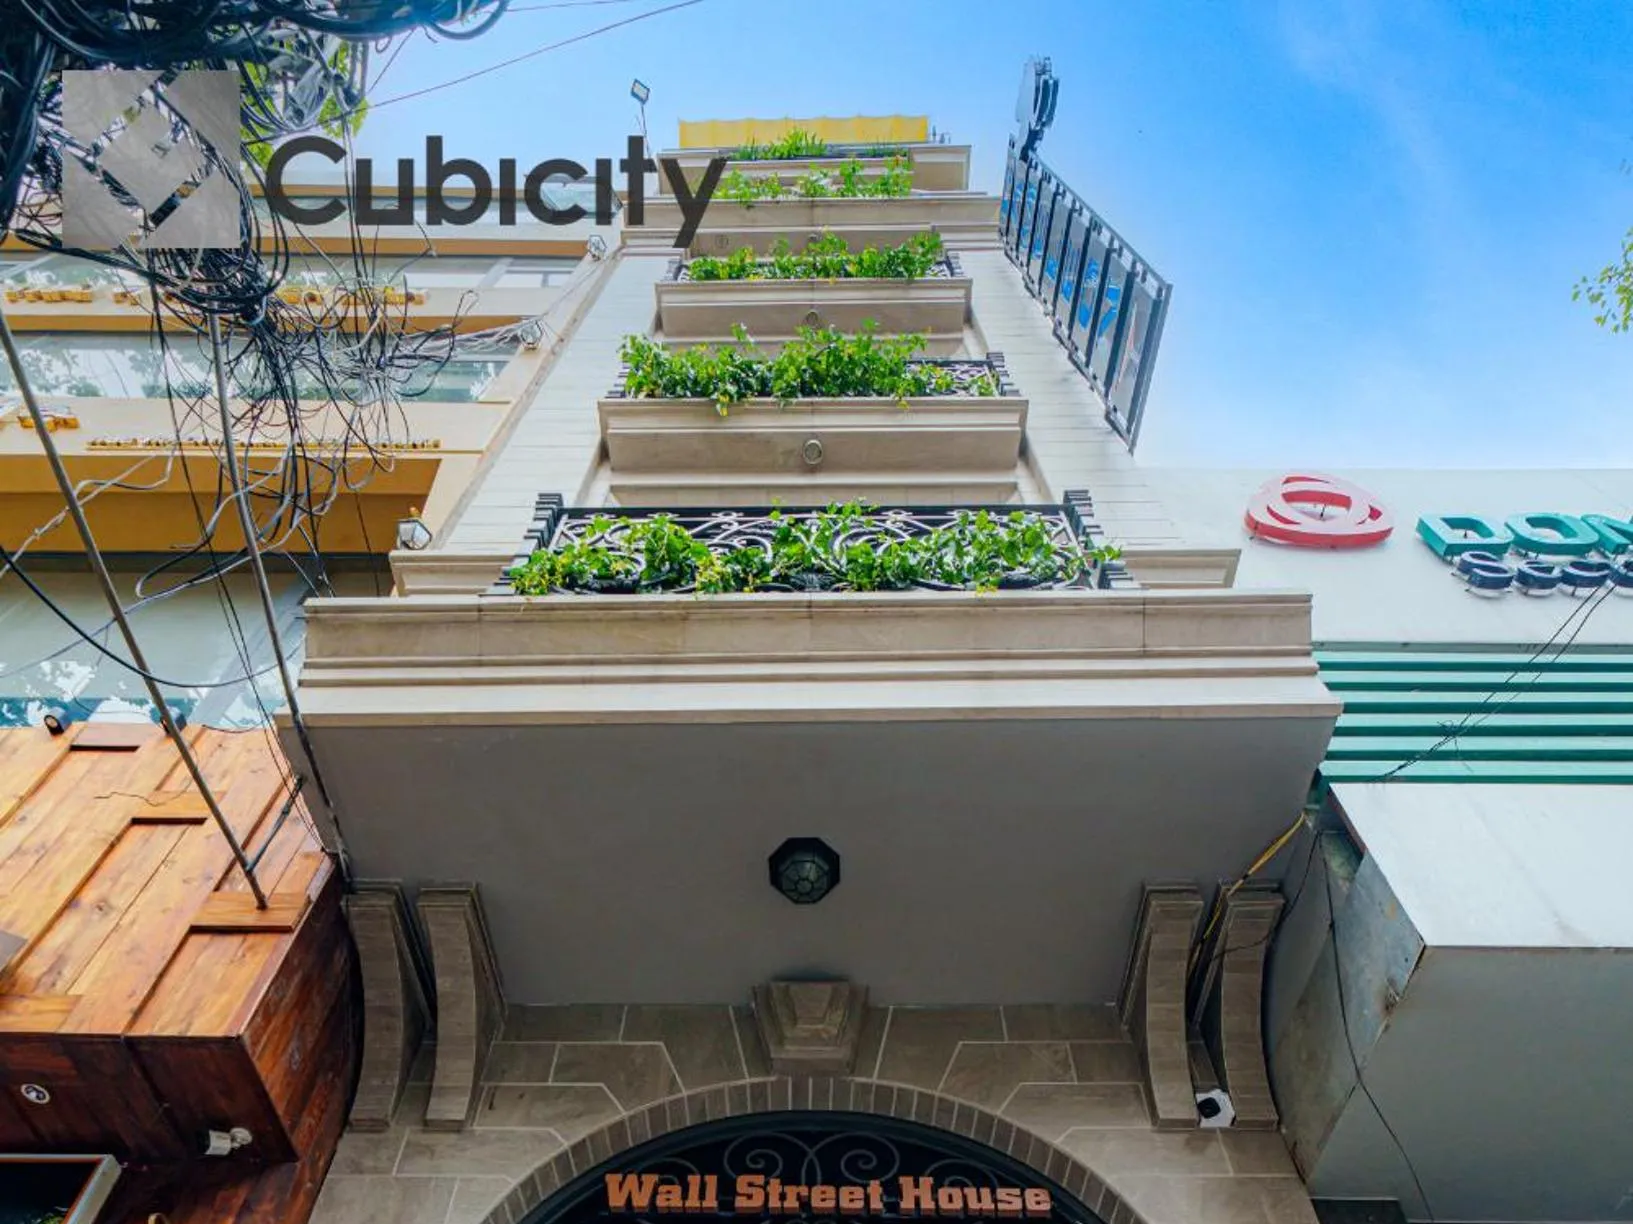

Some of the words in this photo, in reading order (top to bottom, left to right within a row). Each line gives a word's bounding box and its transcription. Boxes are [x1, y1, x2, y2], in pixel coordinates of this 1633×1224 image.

[605, 1173, 719, 1212] Wall
[733, 1174, 884, 1214] Street
[898, 1176, 1053, 1217] House
